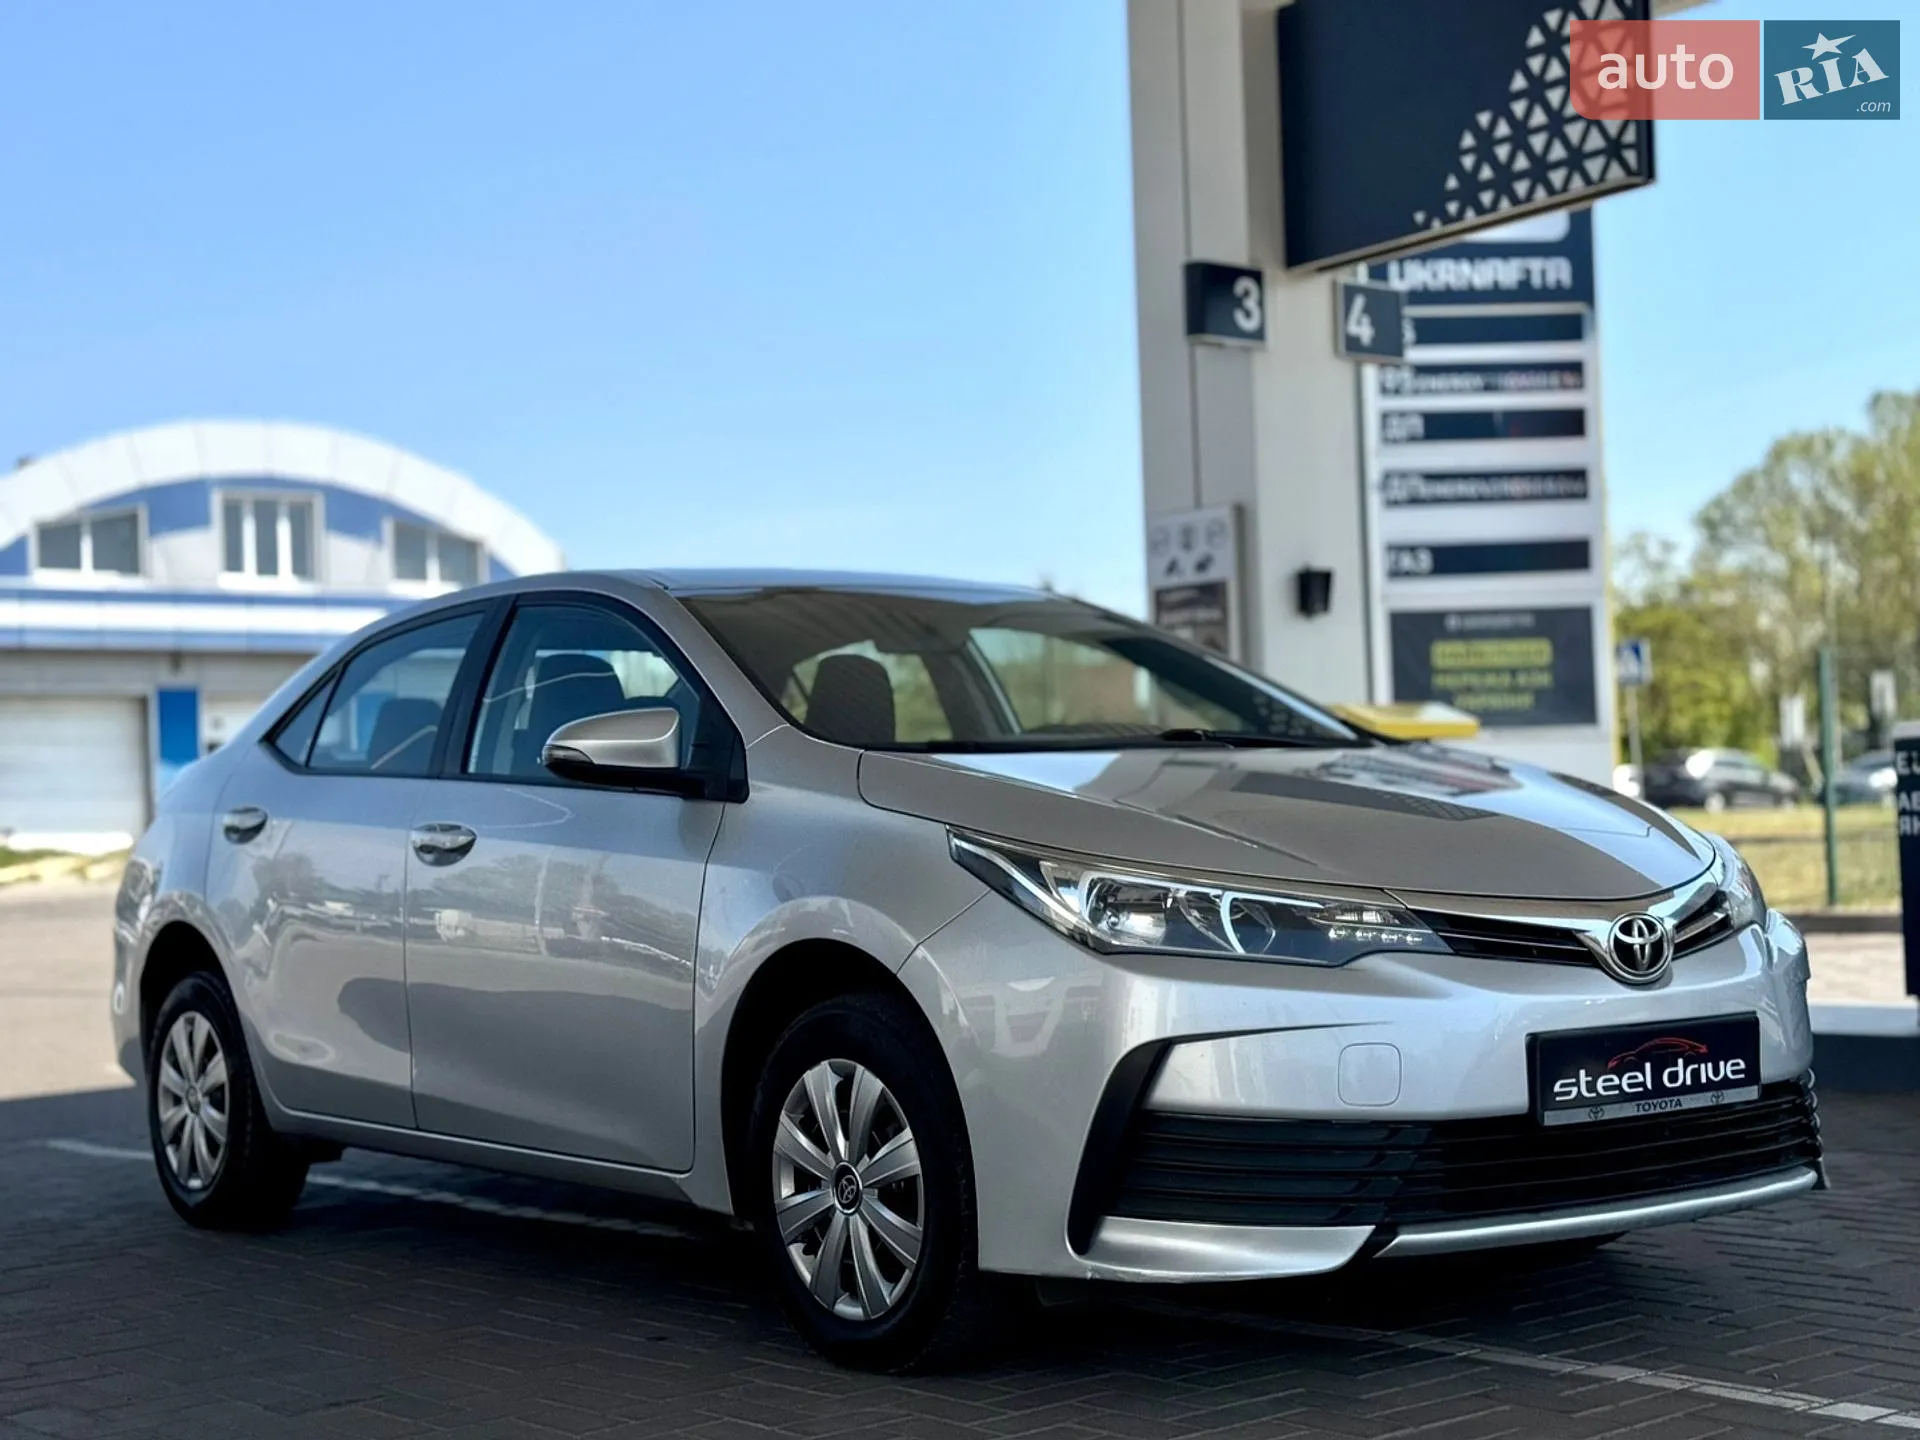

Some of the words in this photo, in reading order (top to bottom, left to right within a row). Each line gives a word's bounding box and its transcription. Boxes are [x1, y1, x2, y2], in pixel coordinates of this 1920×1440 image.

[1387, 256, 1573, 292] UKRNAFTA
[1232, 275, 1262, 333] 3
[1346, 293, 1375, 347] 4
[1553, 1061, 1653, 1101] steel
[1662, 1057, 1746, 1089] drive
[1634, 1098, 1684, 1113] TOYOTA
